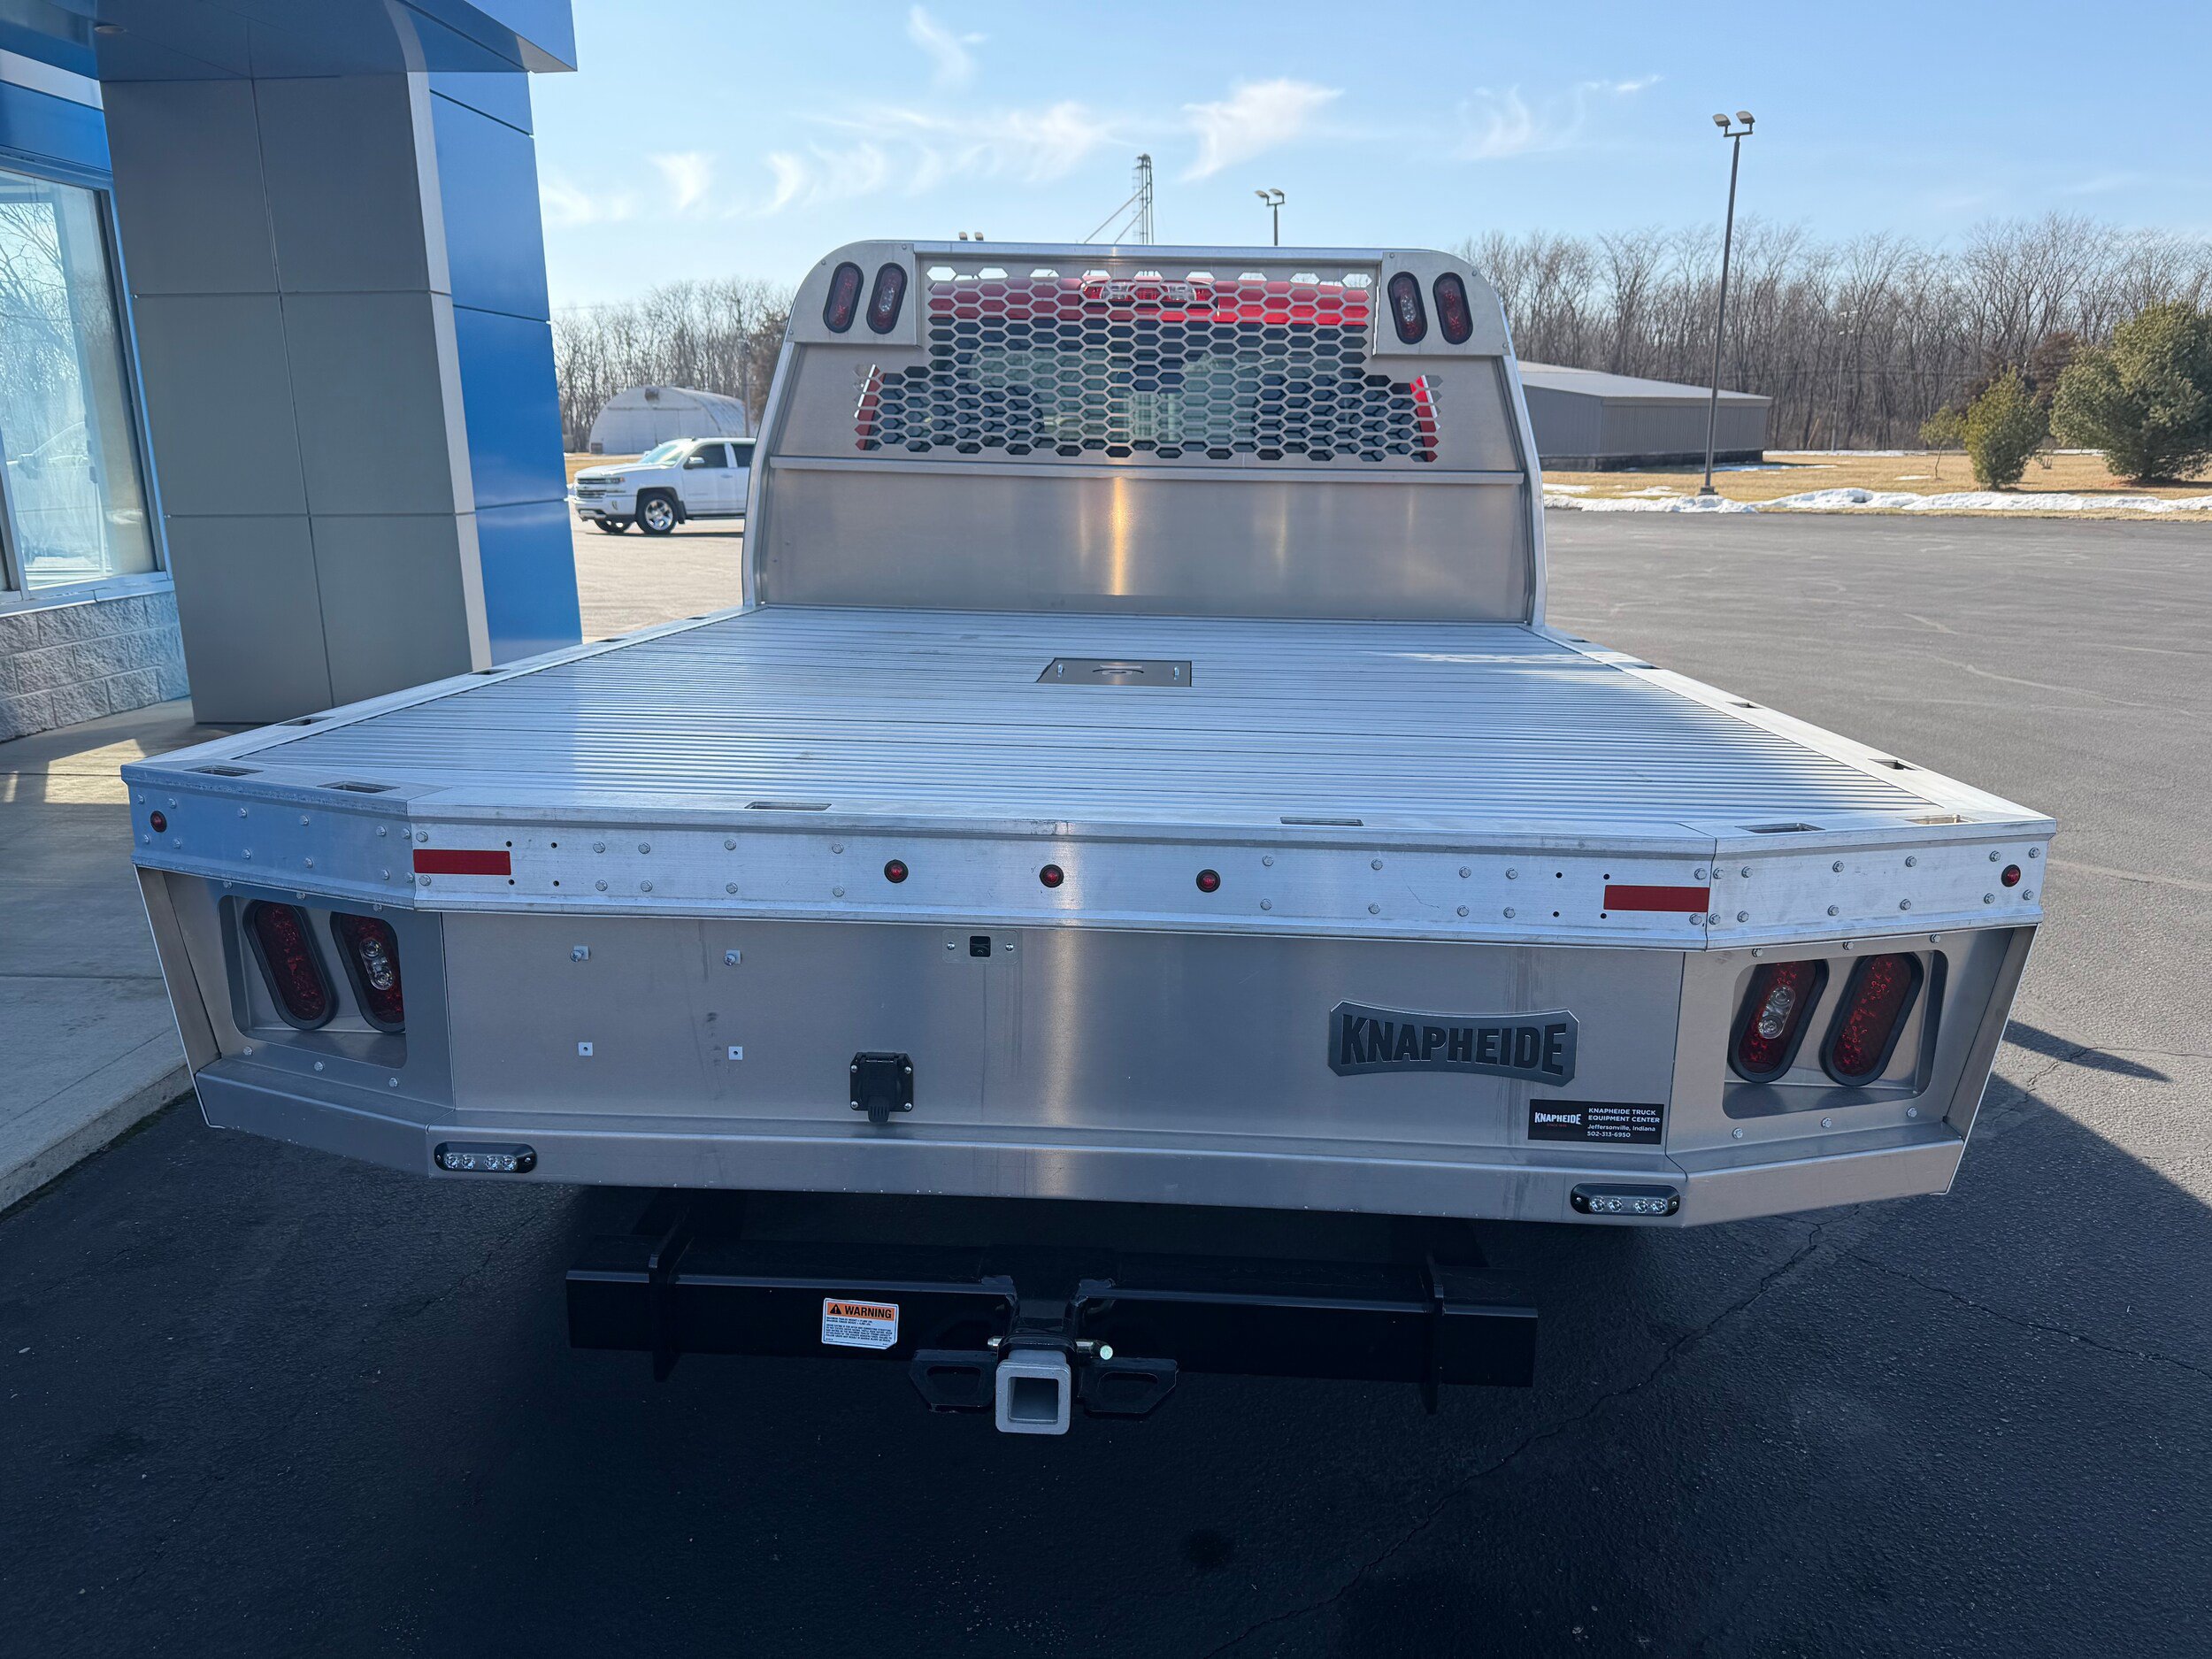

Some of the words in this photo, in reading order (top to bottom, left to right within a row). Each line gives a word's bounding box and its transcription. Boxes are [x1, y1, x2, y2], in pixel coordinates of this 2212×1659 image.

[1340, 1014, 1567, 1076] KNAPHEIDE
[1534, 1112, 1582, 1125] KNAPHEIDE
[844, 1305, 892, 1318] WARNING
